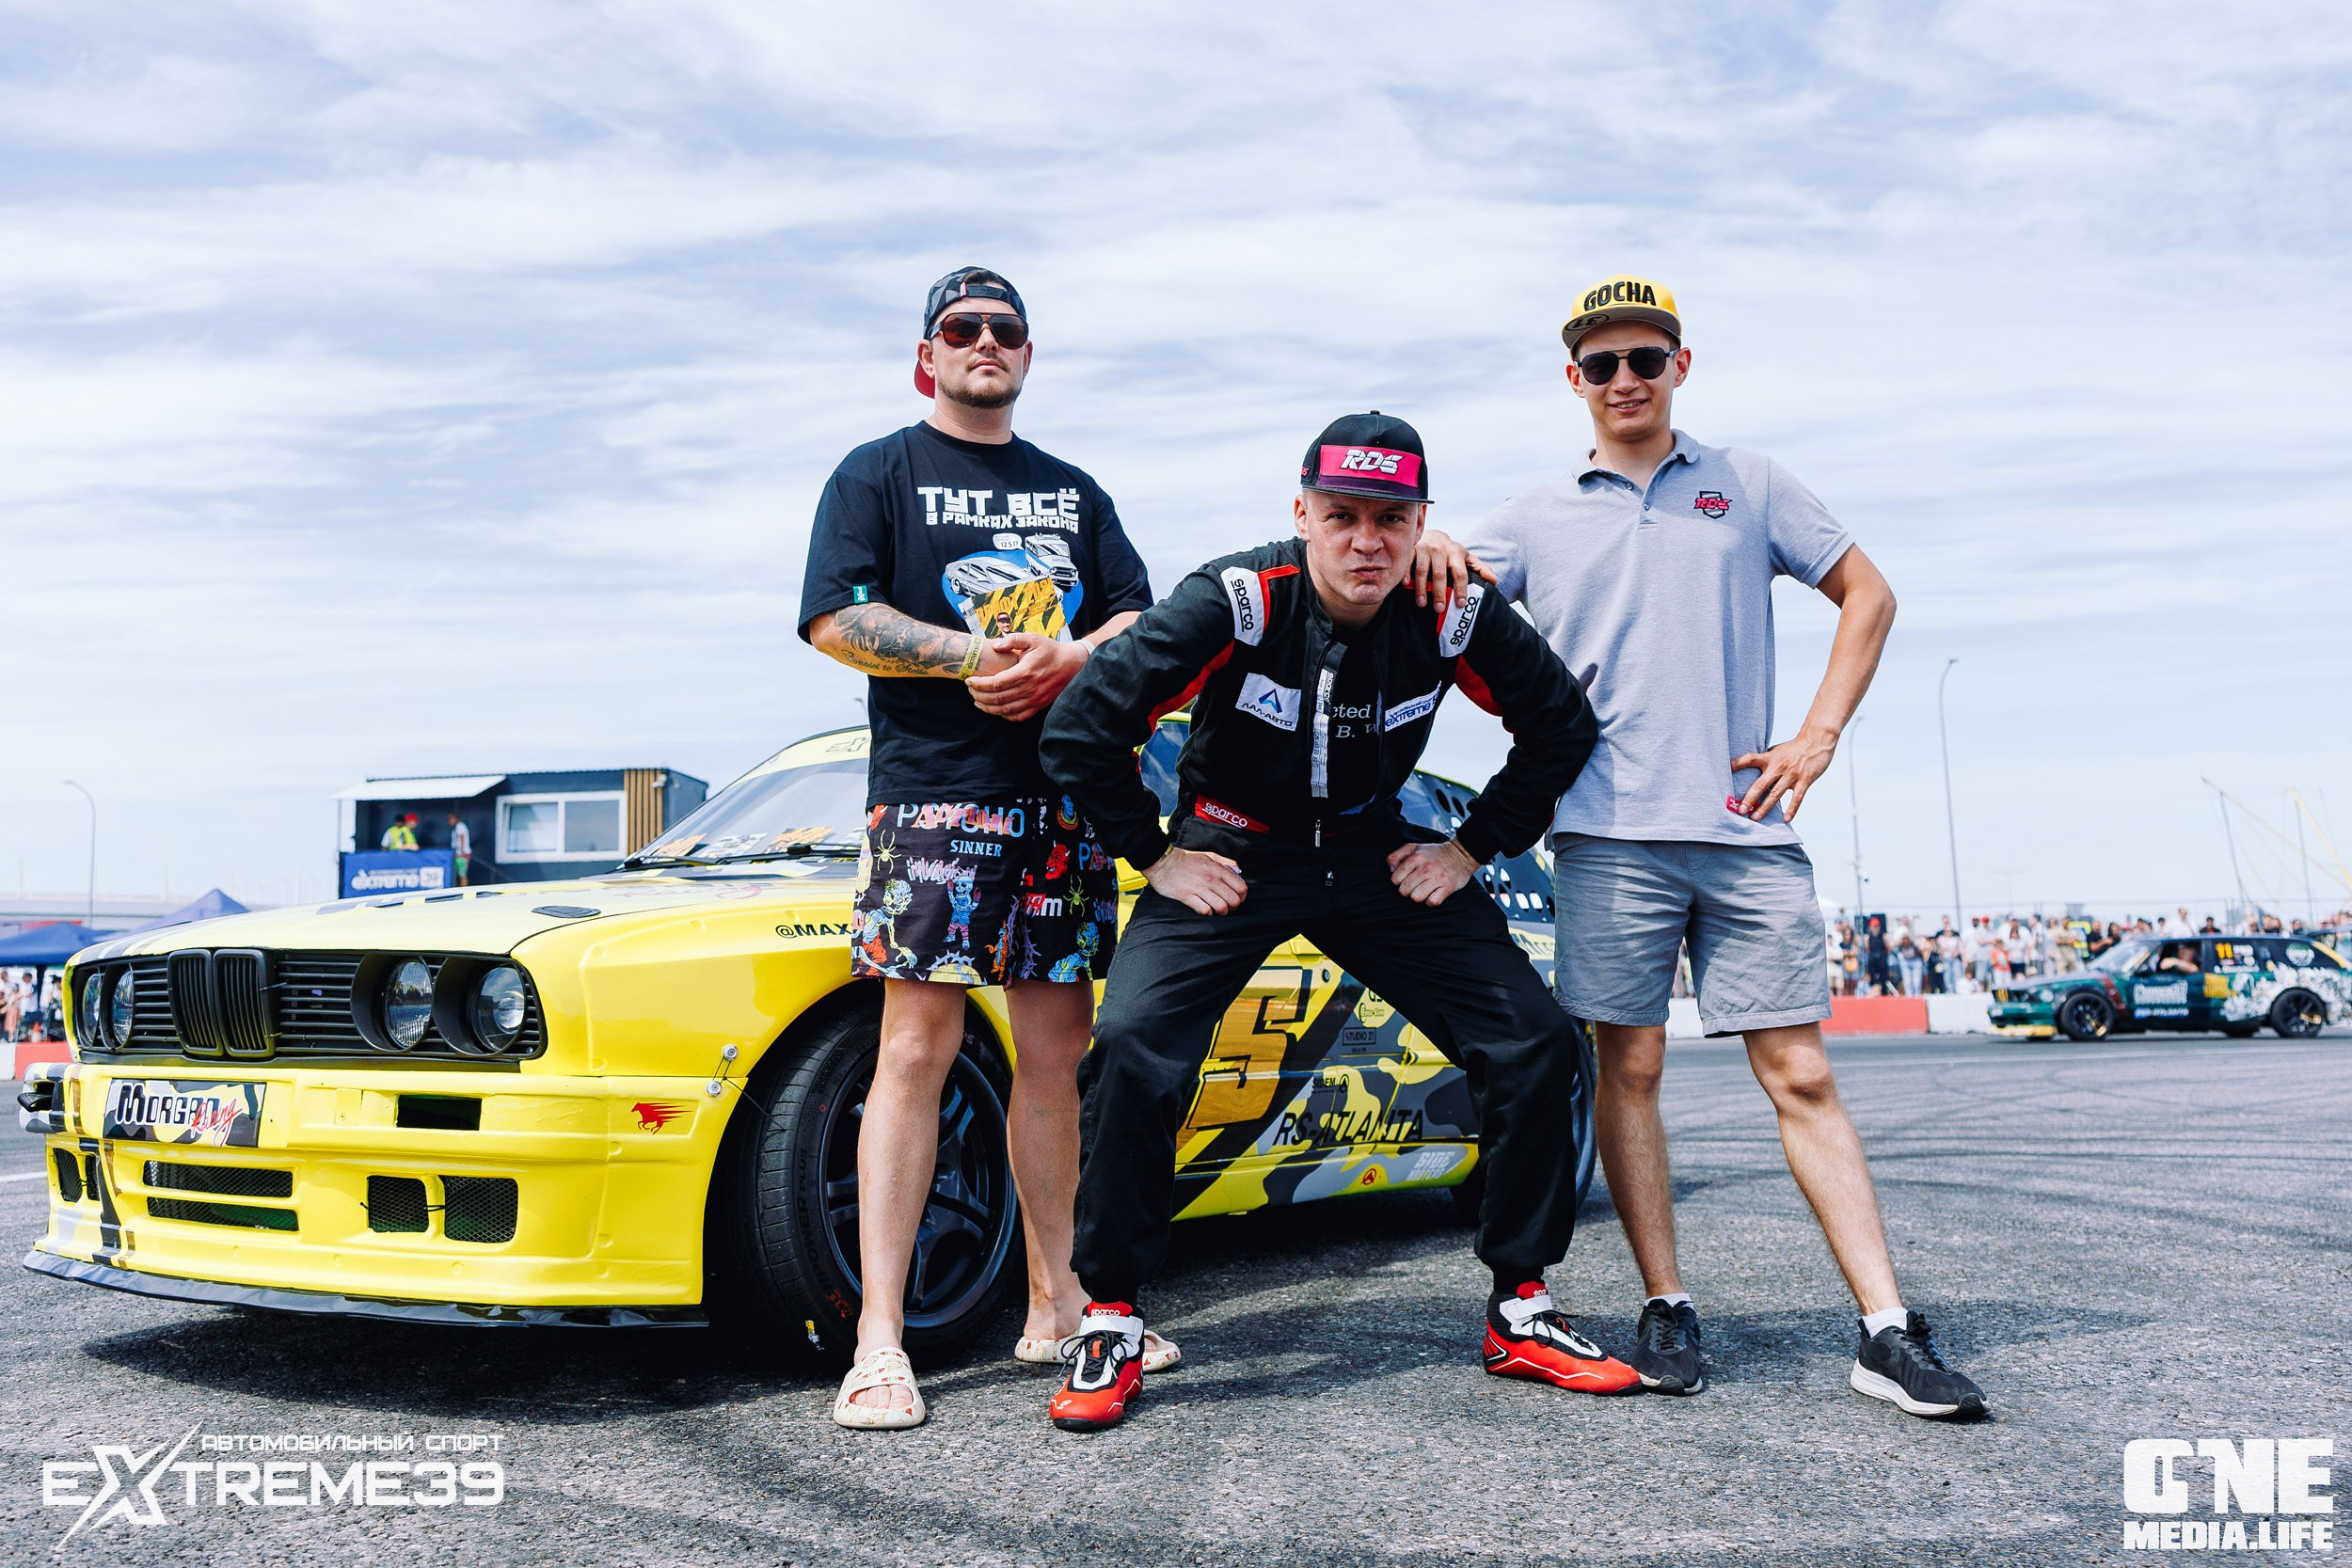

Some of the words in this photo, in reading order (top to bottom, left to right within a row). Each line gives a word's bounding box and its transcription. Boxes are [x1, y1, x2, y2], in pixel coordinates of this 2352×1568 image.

[1583, 281, 1657, 311] GOCHA
[1340, 449, 1404, 475] RDS
[917, 486, 993, 515] ТУТ
[1007, 488, 1080, 521] ВСЁ
[1693, 498, 1733, 511] RDS
[926, 512, 938, 525] В
[943, 511, 1013, 529] РАМКАХ
[1015, 515, 1079, 533] ЗАКОНА
[1231, 578, 1254, 632] sparco
[1450, 596, 1479, 647] sparco
[1202, 802, 1248, 828] sparco
[950, 839, 1003, 858] SINNER
[1272, 1109, 1423, 1146] RS-ATLANTA
